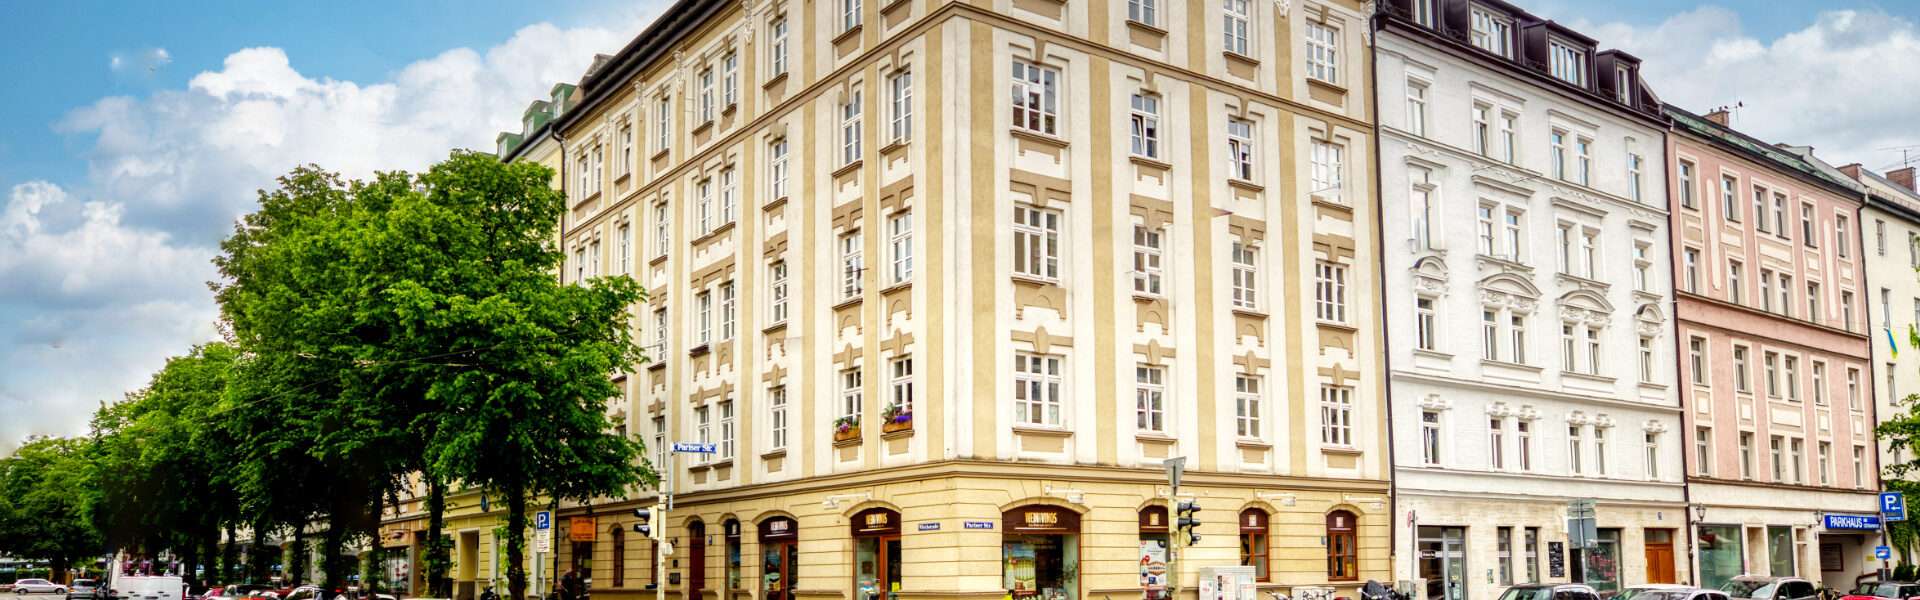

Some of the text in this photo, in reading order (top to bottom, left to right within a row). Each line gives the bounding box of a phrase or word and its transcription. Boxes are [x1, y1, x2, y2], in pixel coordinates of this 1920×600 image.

[1884, 495, 1896, 510] P
[538, 514, 546, 528] P
[1830, 516, 1863, 528] PARKHAUS
